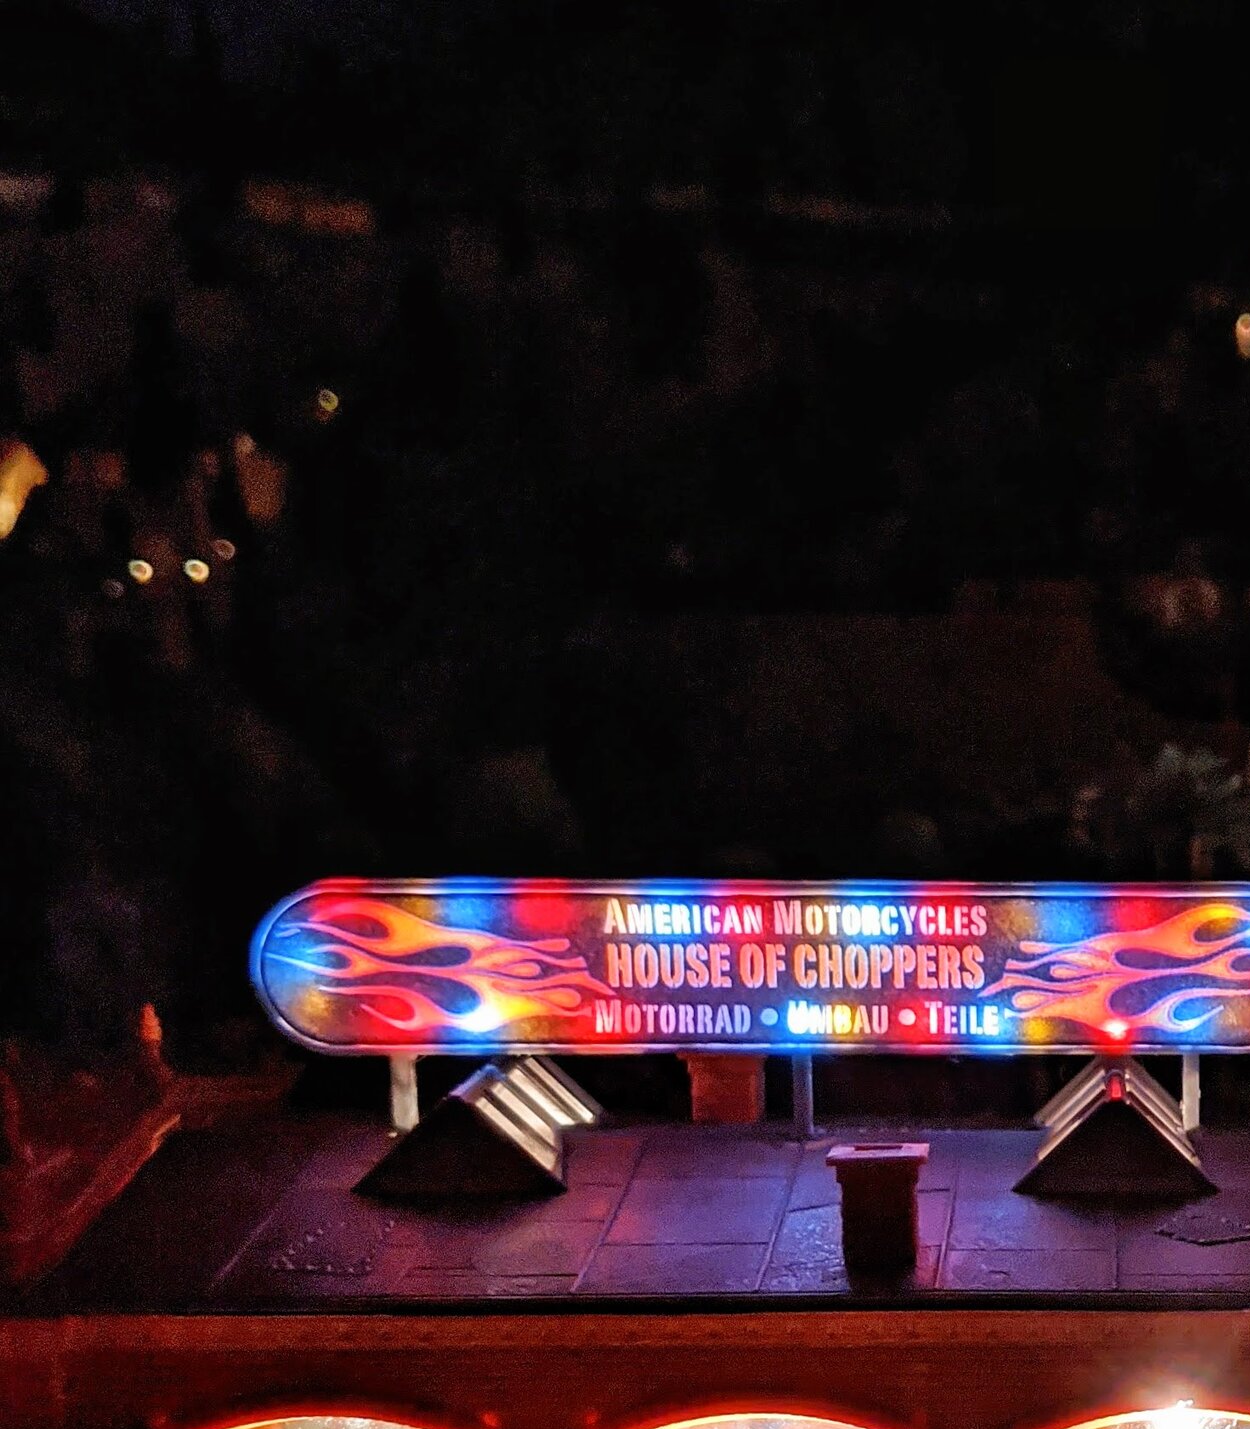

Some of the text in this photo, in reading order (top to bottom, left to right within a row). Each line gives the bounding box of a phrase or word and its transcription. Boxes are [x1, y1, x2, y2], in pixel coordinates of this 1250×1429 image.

[607, 943, 985, 988] HOUSE OF CHOPPERS
